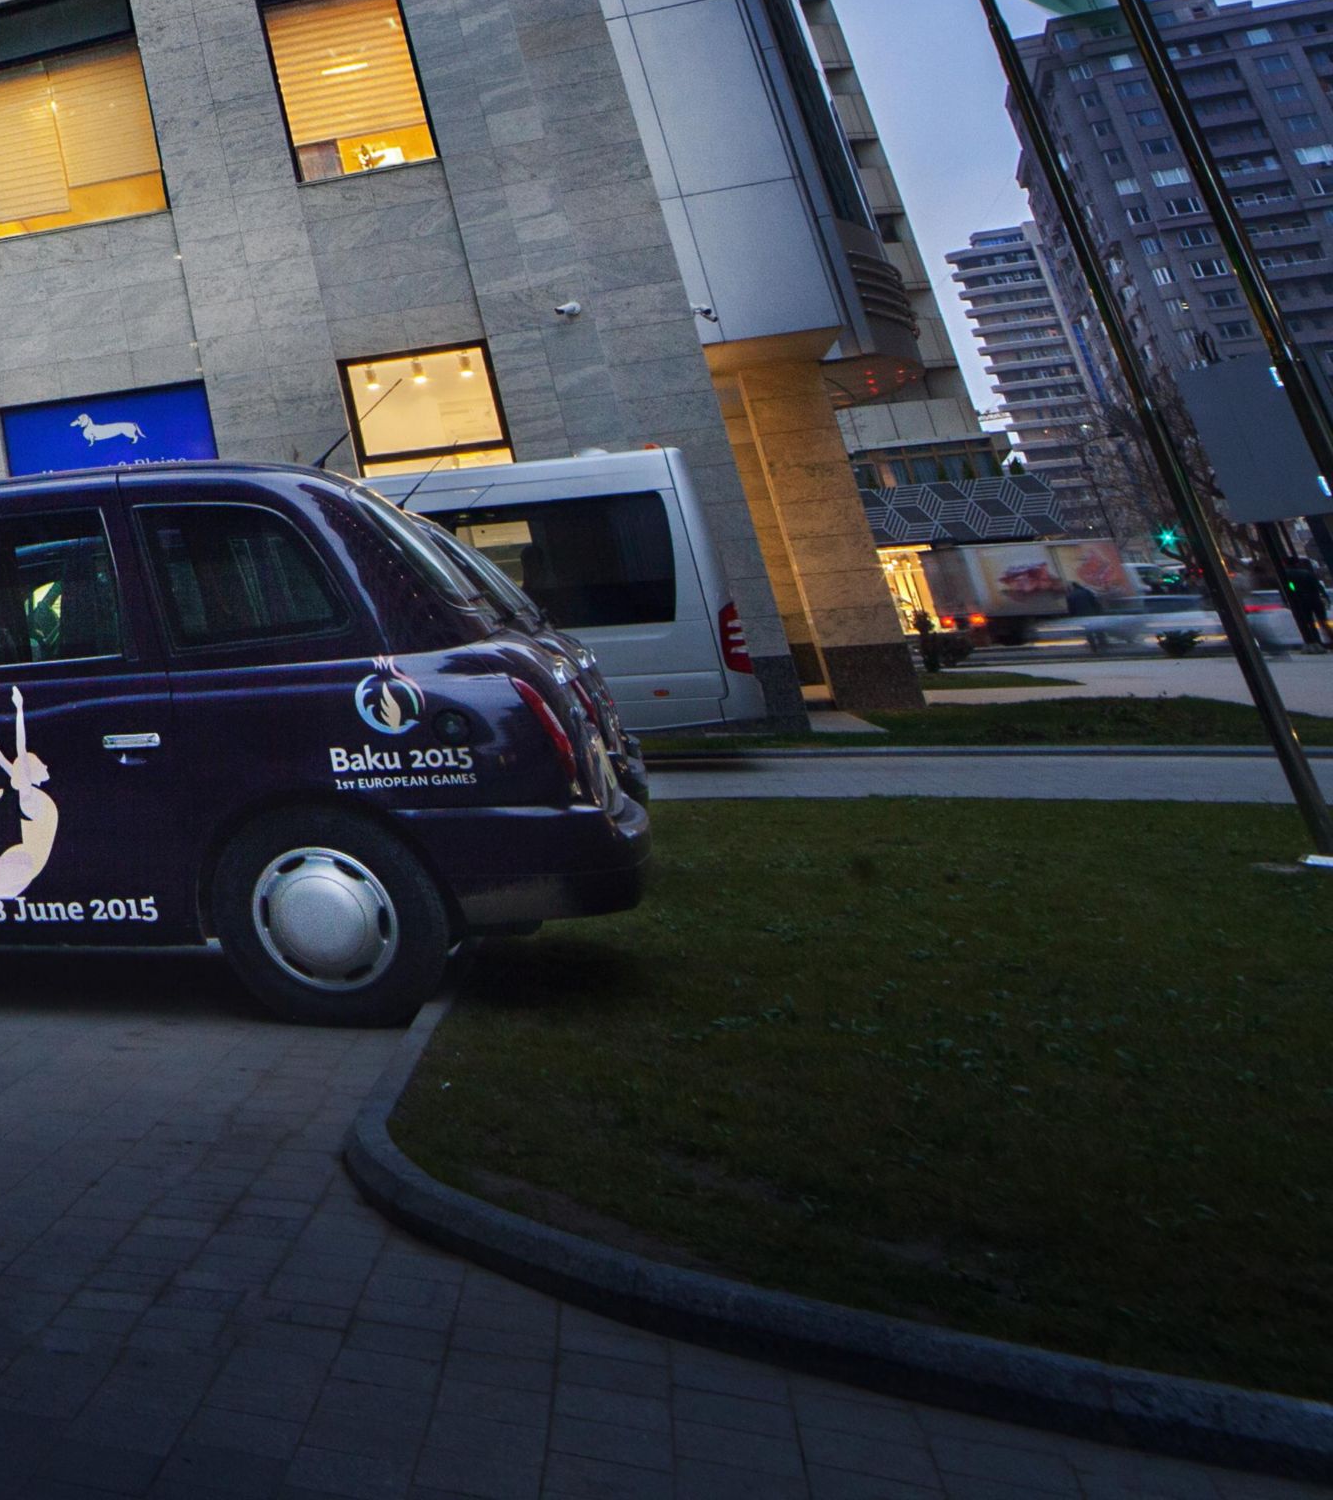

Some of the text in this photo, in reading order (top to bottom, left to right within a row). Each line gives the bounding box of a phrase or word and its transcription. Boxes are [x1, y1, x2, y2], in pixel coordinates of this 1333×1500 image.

[329, 744, 473, 773] Baku 2015
[357, 775, 429, 789] EUROPEAN
[431, 772, 477, 786] GAMES
[14, 896, 85, 922] June
[90, 896, 158, 922] 2015
